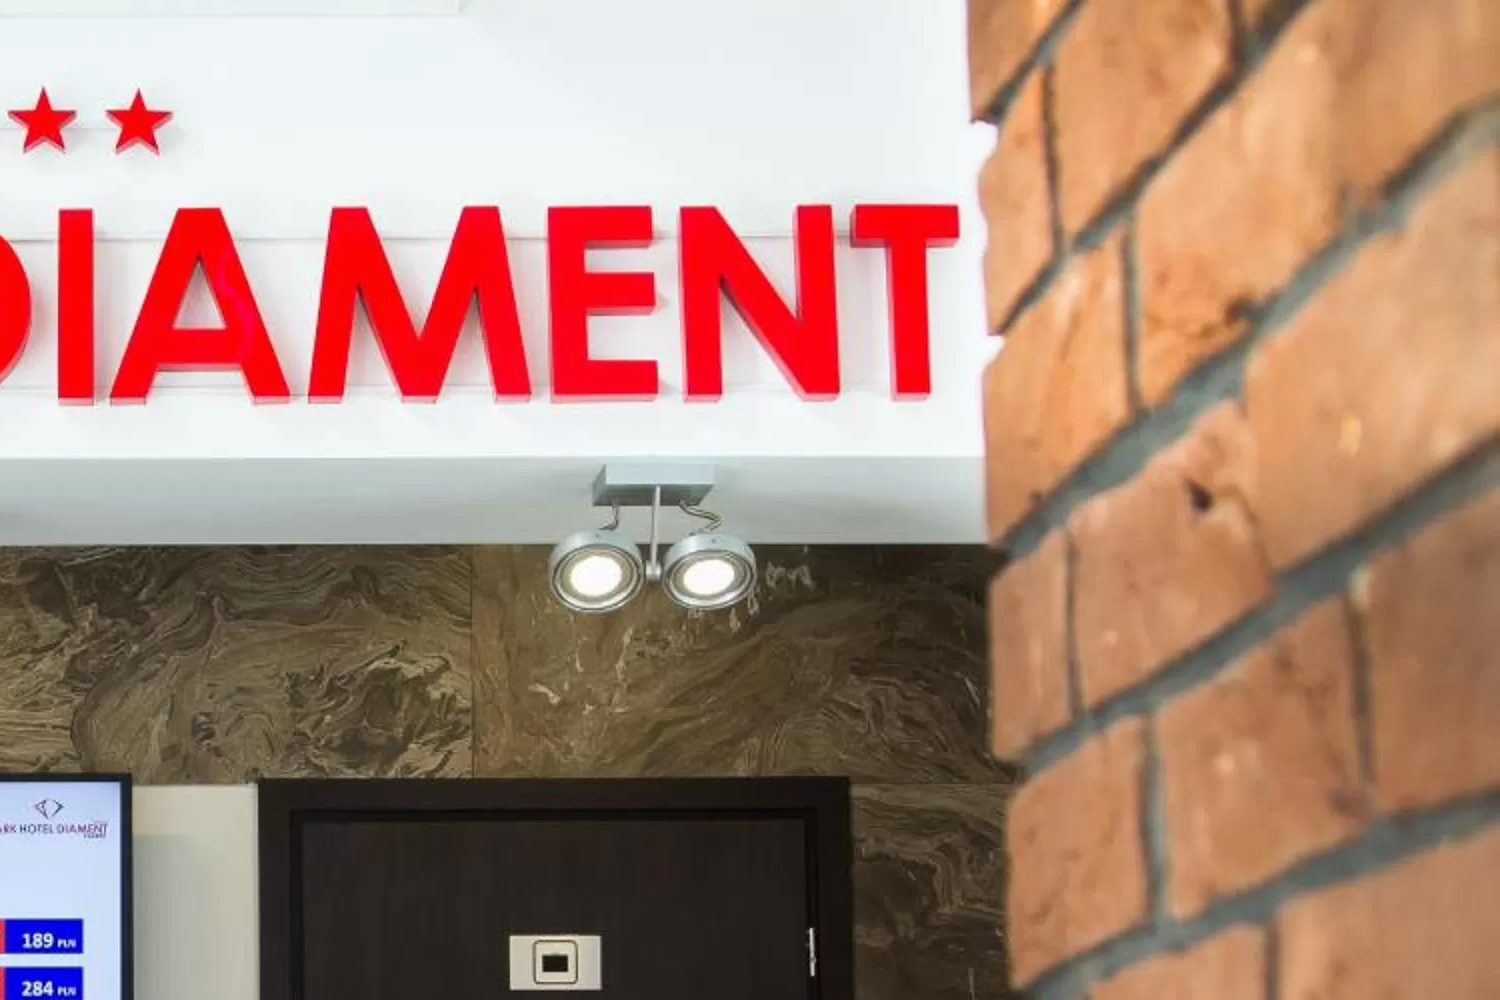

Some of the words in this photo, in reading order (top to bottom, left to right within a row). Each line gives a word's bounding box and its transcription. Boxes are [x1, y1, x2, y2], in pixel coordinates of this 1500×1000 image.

[19, 822, 54, 835] HOTEL
[56, 821, 108, 834] DIAMENT
[21, 932, 54, 949] 189
[57, 938, 77, 949] PLN
[21, 980, 54, 997] 284
[57, 985, 77, 996] PLN
